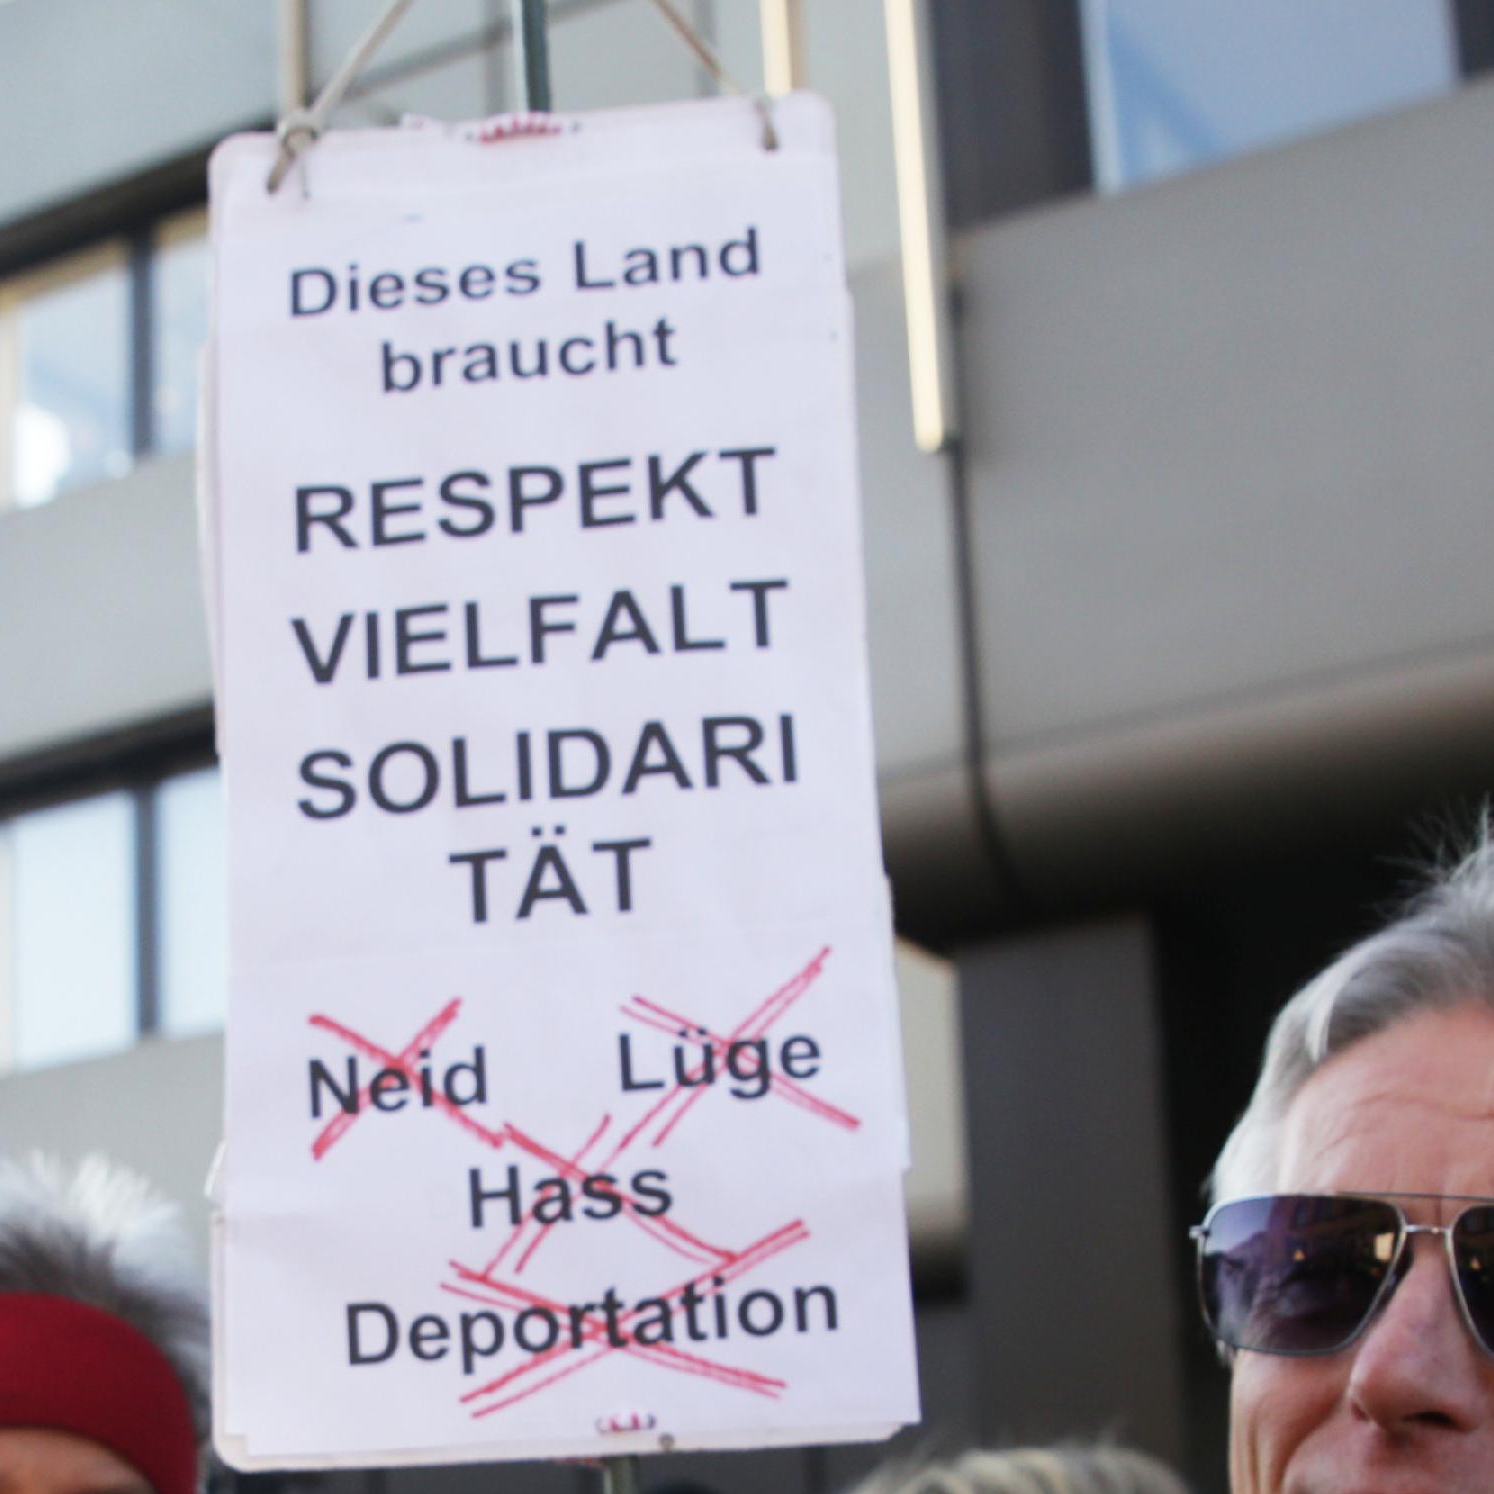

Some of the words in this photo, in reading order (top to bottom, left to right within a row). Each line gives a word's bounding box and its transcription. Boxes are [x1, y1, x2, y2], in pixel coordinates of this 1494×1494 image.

[290, 254, 542, 319] Dieses
[574, 226, 762, 291] Land
[381, 317, 678, 393] braucht
[295, 447, 777, 554] RESPEKT
[291, 579, 789, 685] VIELFALT
[298, 714, 799, 821] SOLIDARI
[449, 824, 654, 925] TÄT
[308, 1045, 487, 1119] Neid
[618, 1026, 821, 1101] Lüge
[468, 1164, 674, 1229] Hass
[346, 1276, 839, 1375] Deportation
